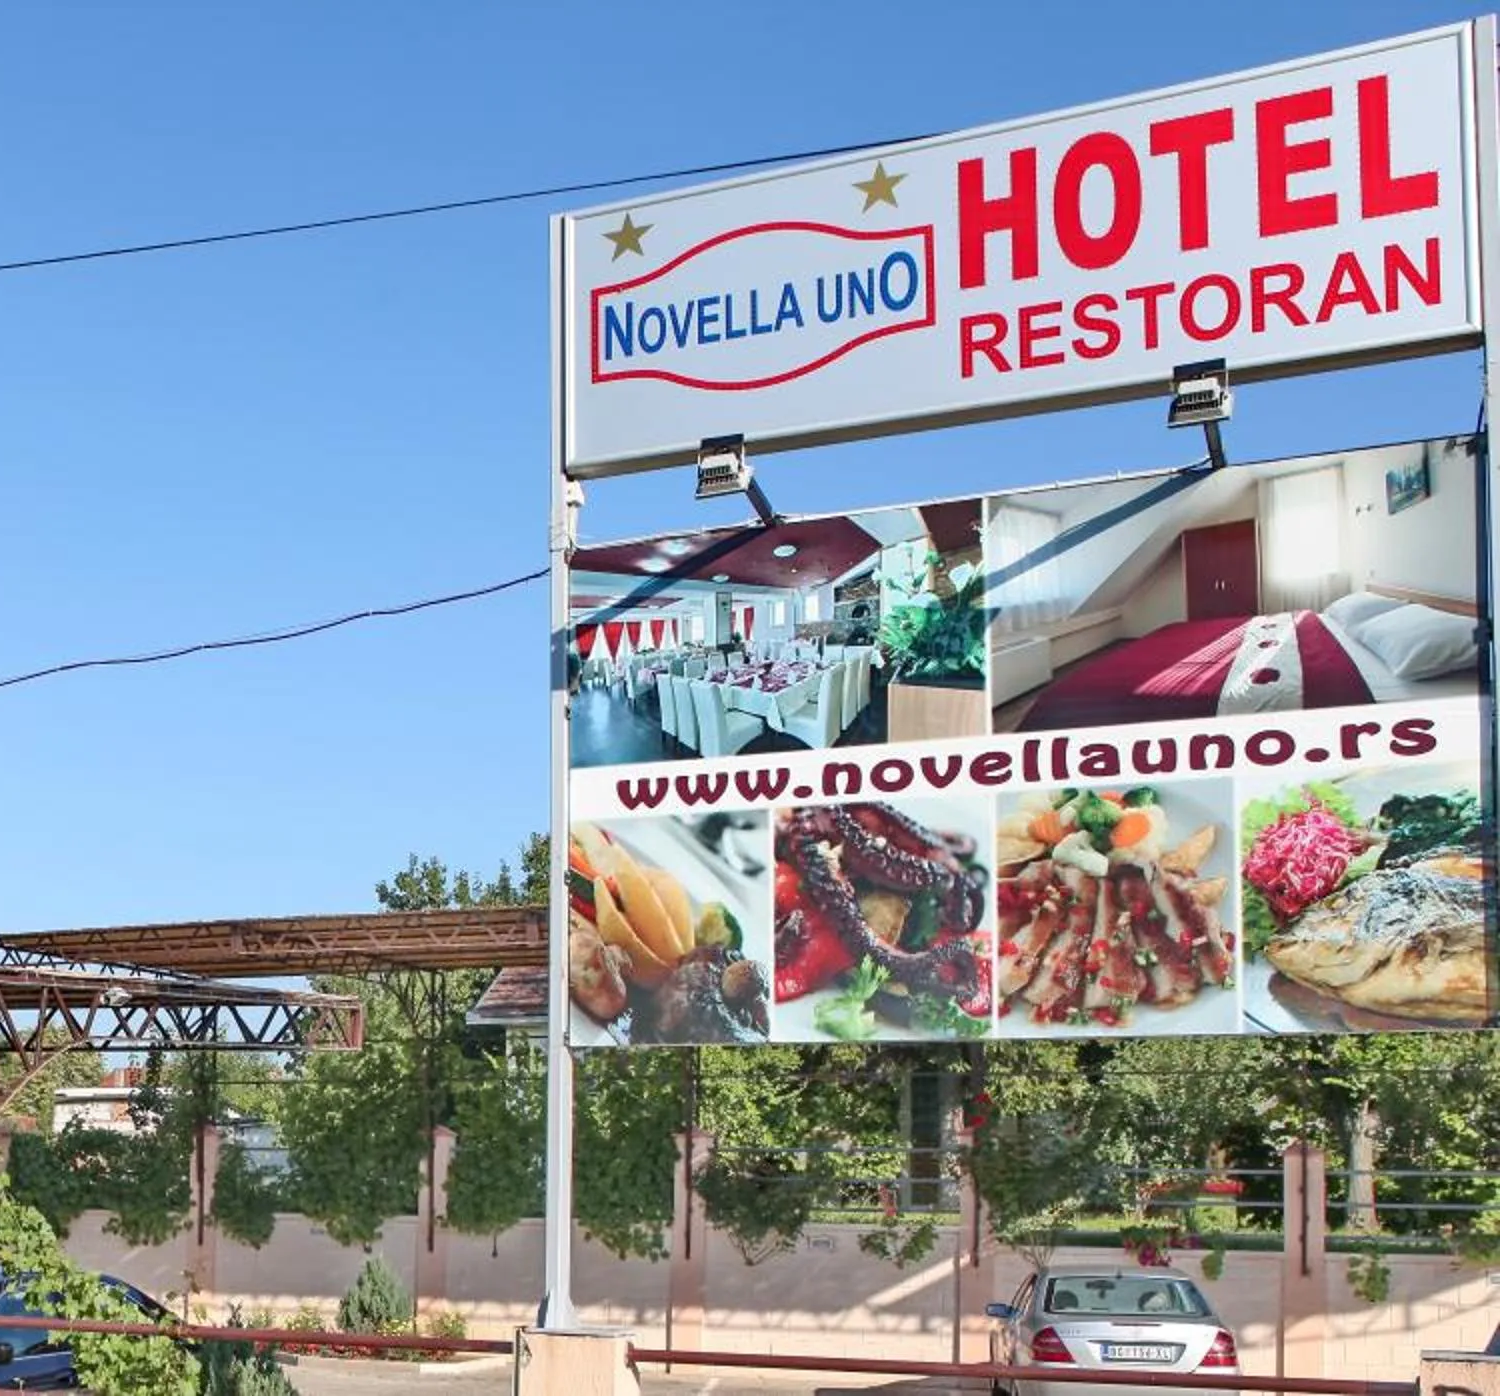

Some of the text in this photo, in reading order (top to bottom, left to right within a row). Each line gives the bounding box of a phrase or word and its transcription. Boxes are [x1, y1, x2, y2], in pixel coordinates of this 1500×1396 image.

[956, 74, 1440, 290] HOTEL
[604, 250, 919, 361] NOVELLA UNO
[959, 236, 1442, 379] RESTORAN
[615, 718, 1438, 811] www.novellauno.rs
